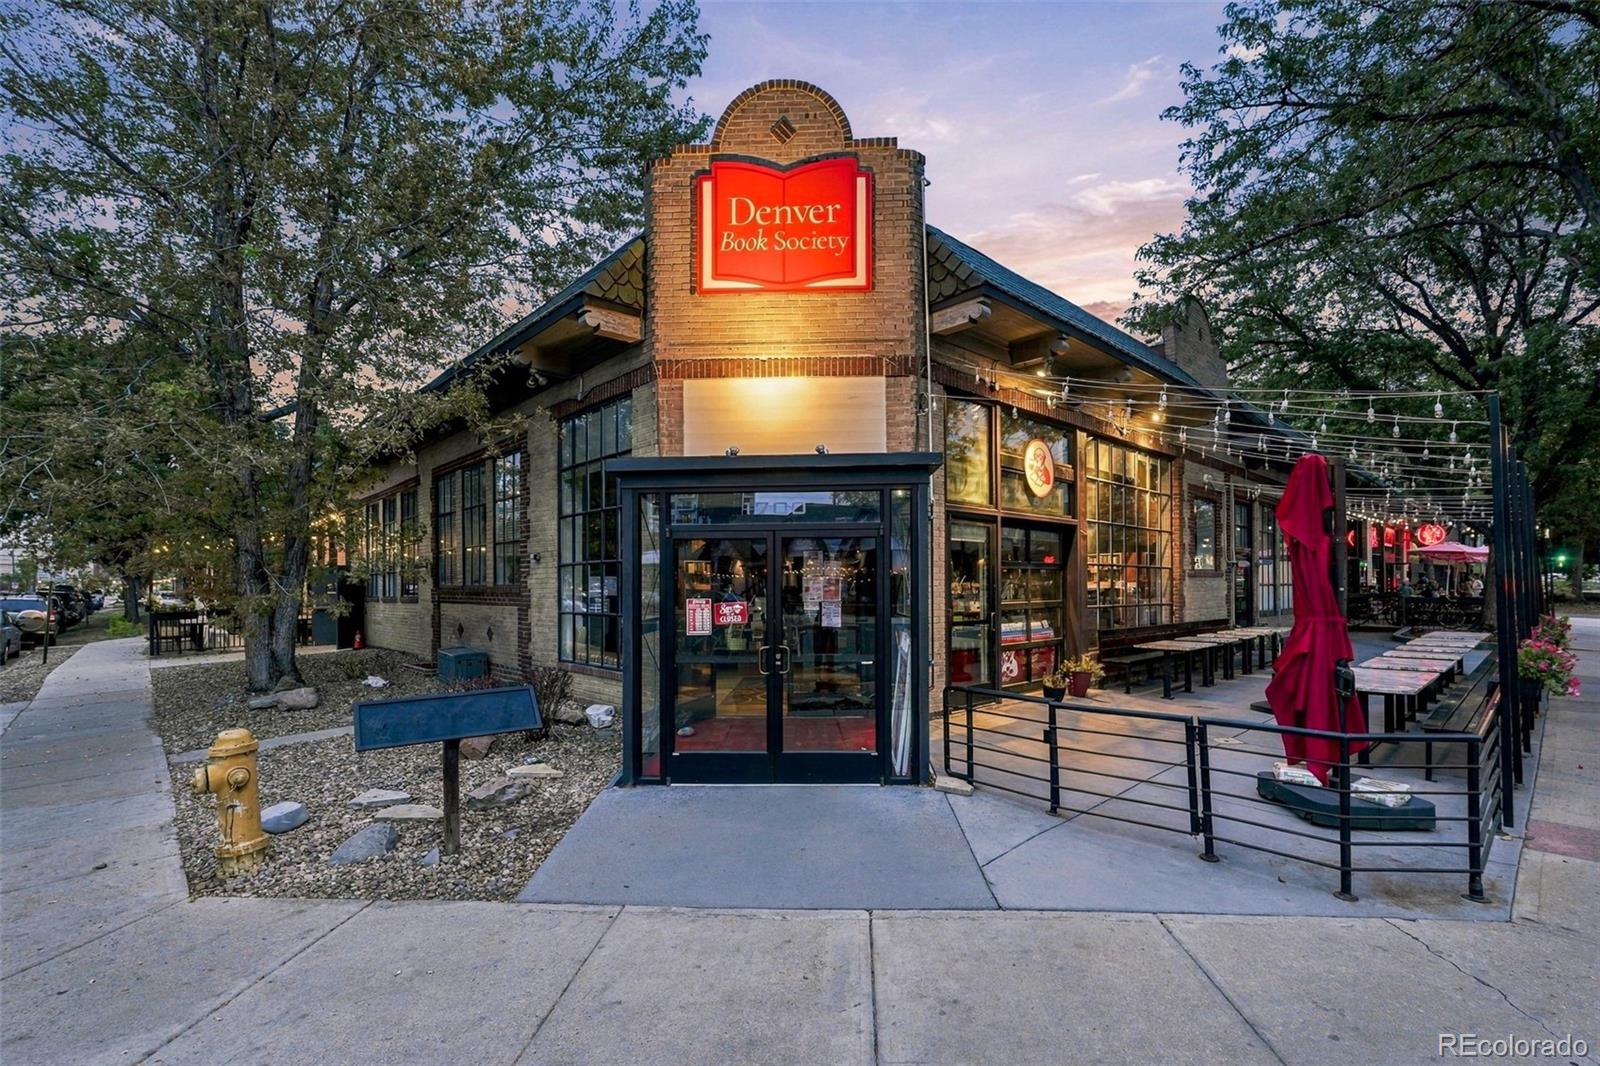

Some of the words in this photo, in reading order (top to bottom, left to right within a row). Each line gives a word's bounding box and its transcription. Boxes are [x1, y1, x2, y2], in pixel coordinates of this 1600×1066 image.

[728, 197, 841, 226] Denver
[720, 229, 768, 252] Book
[773, 231, 849, 256] Society
